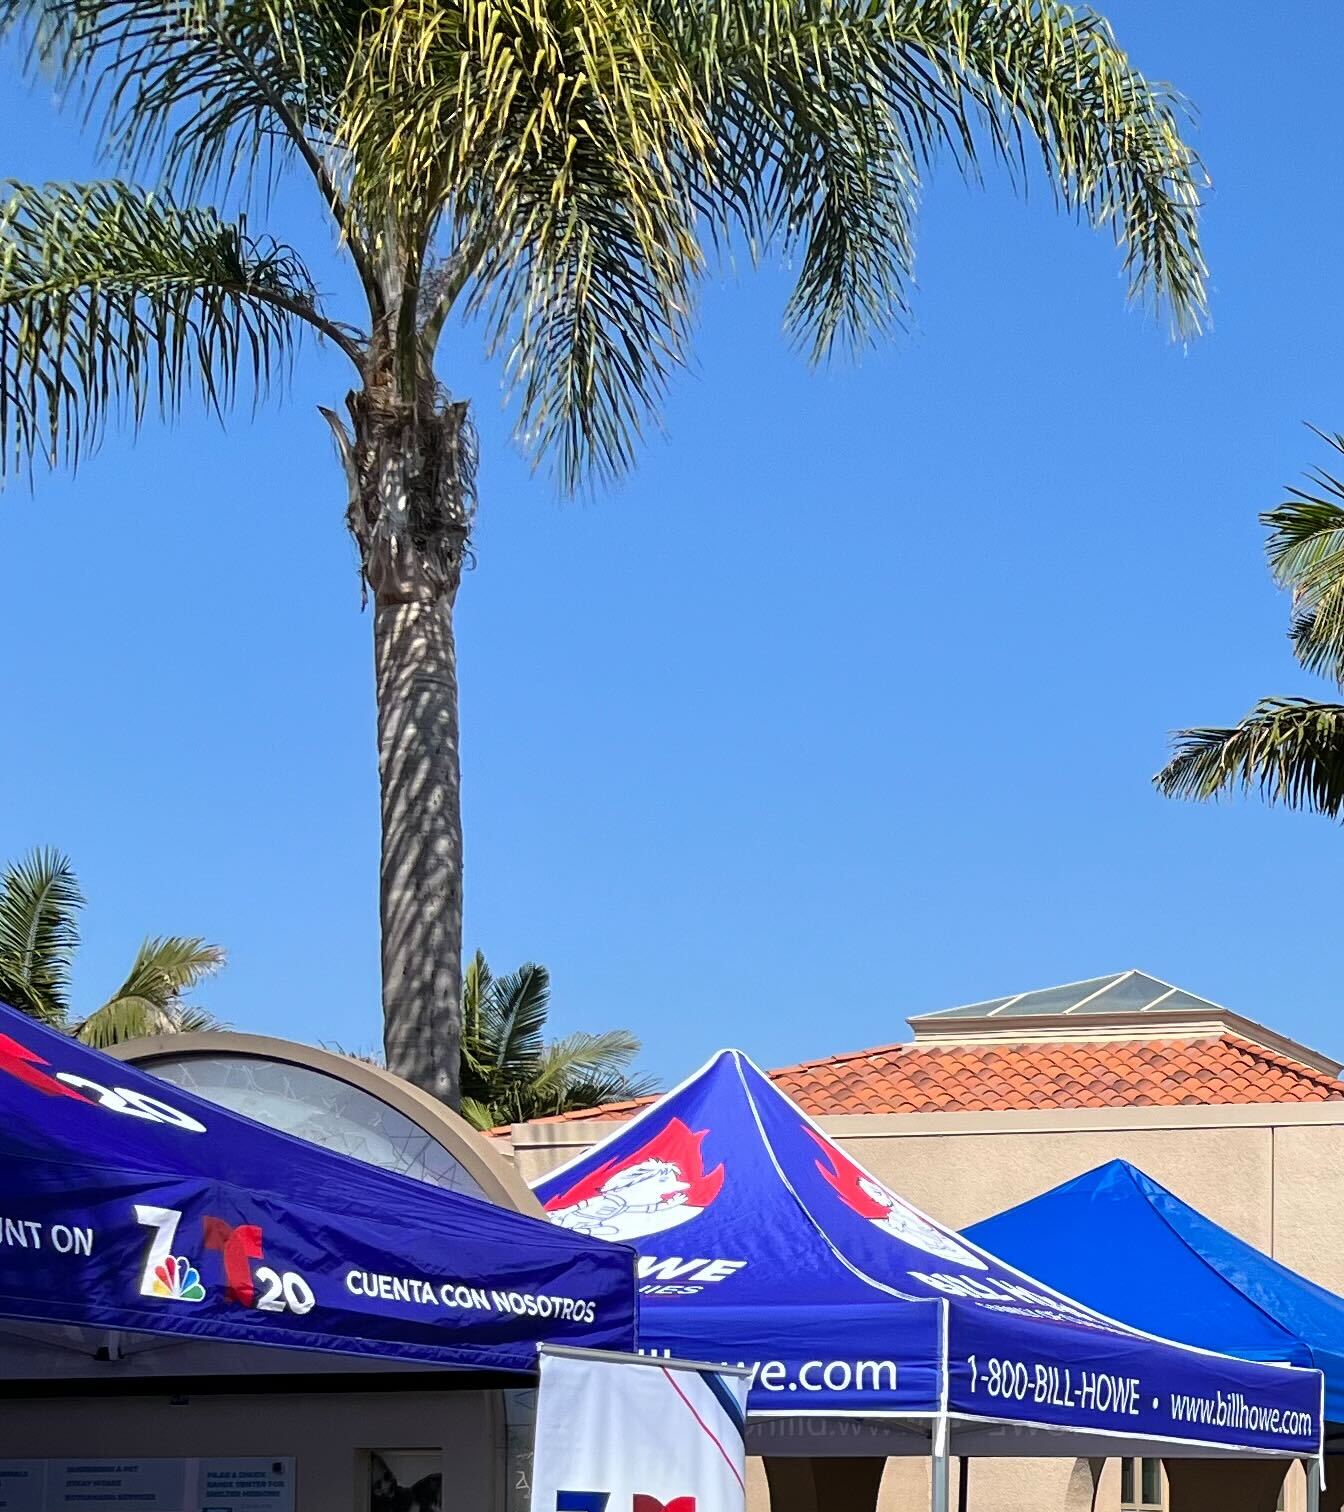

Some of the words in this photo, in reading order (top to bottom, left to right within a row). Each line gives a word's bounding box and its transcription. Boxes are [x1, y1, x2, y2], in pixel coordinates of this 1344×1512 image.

[0, 1217, 42, 1250] NT
[52, 1225, 94, 1257] ON
[134, 1204, 182, 1297] 7
[255, 1267, 315, 1315] 20
[638, 1256, 748, 1282] WE
[346, 1270, 438, 1305] CUENTA
[441, 1284, 491, 1311] CON
[492, 1290, 596, 1323] NOSOTROS
[750, 1359, 897, 1391] e.com
[967, 1355, 1140, 1415] 1-800-BILL-HOWE
[1171, 1390, 1312, 1437] www.billhowe.com
